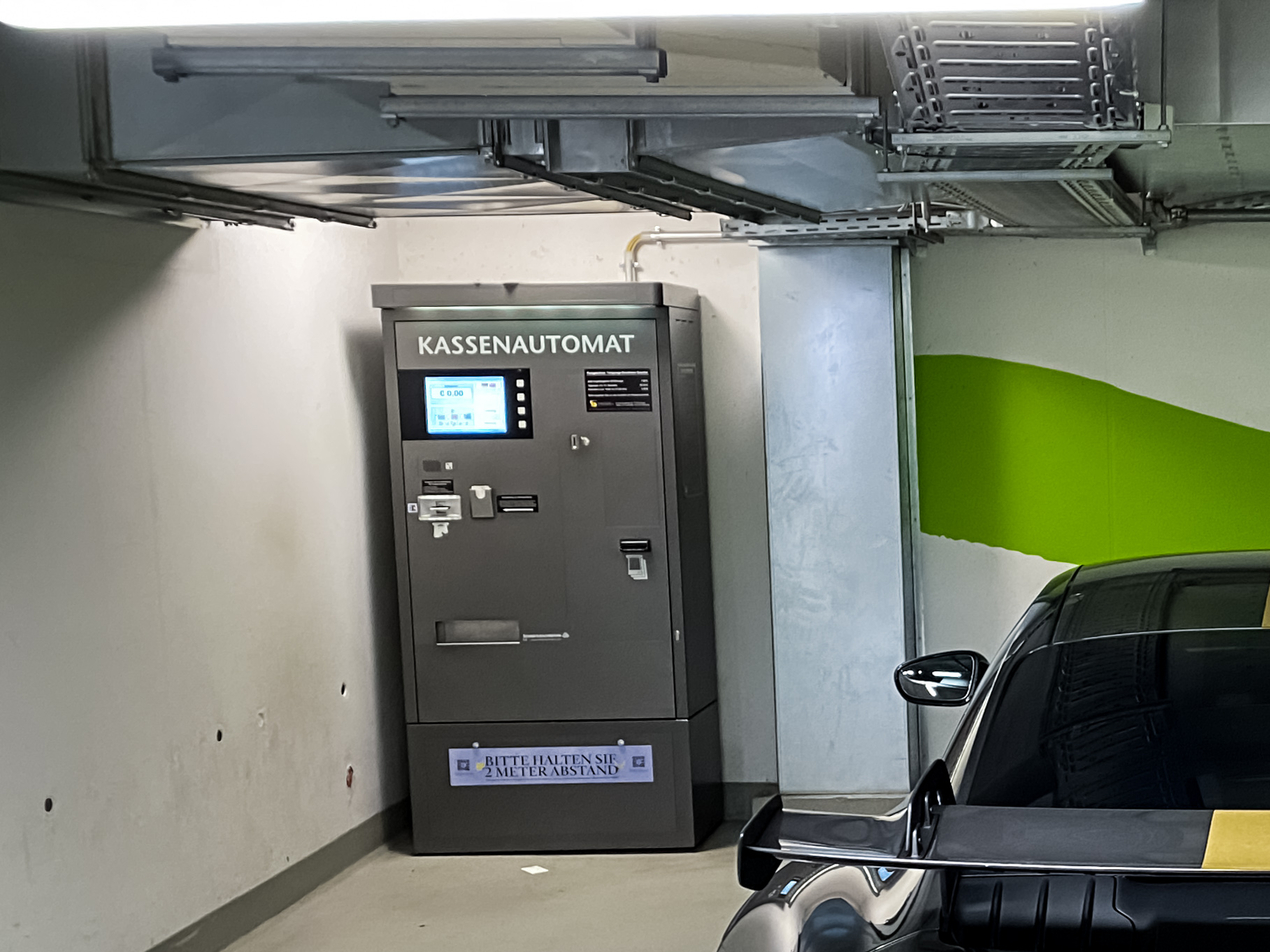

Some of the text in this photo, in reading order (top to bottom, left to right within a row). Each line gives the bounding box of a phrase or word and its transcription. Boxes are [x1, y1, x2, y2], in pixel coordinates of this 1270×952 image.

[417, 334, 635, 356] KASSENAUTOMAT
[485, 755, 529, 766] BITTE
[533, 754, 591, 766] HALTEN
[485, 765, 619, 778] 2 METER ABSTAND
